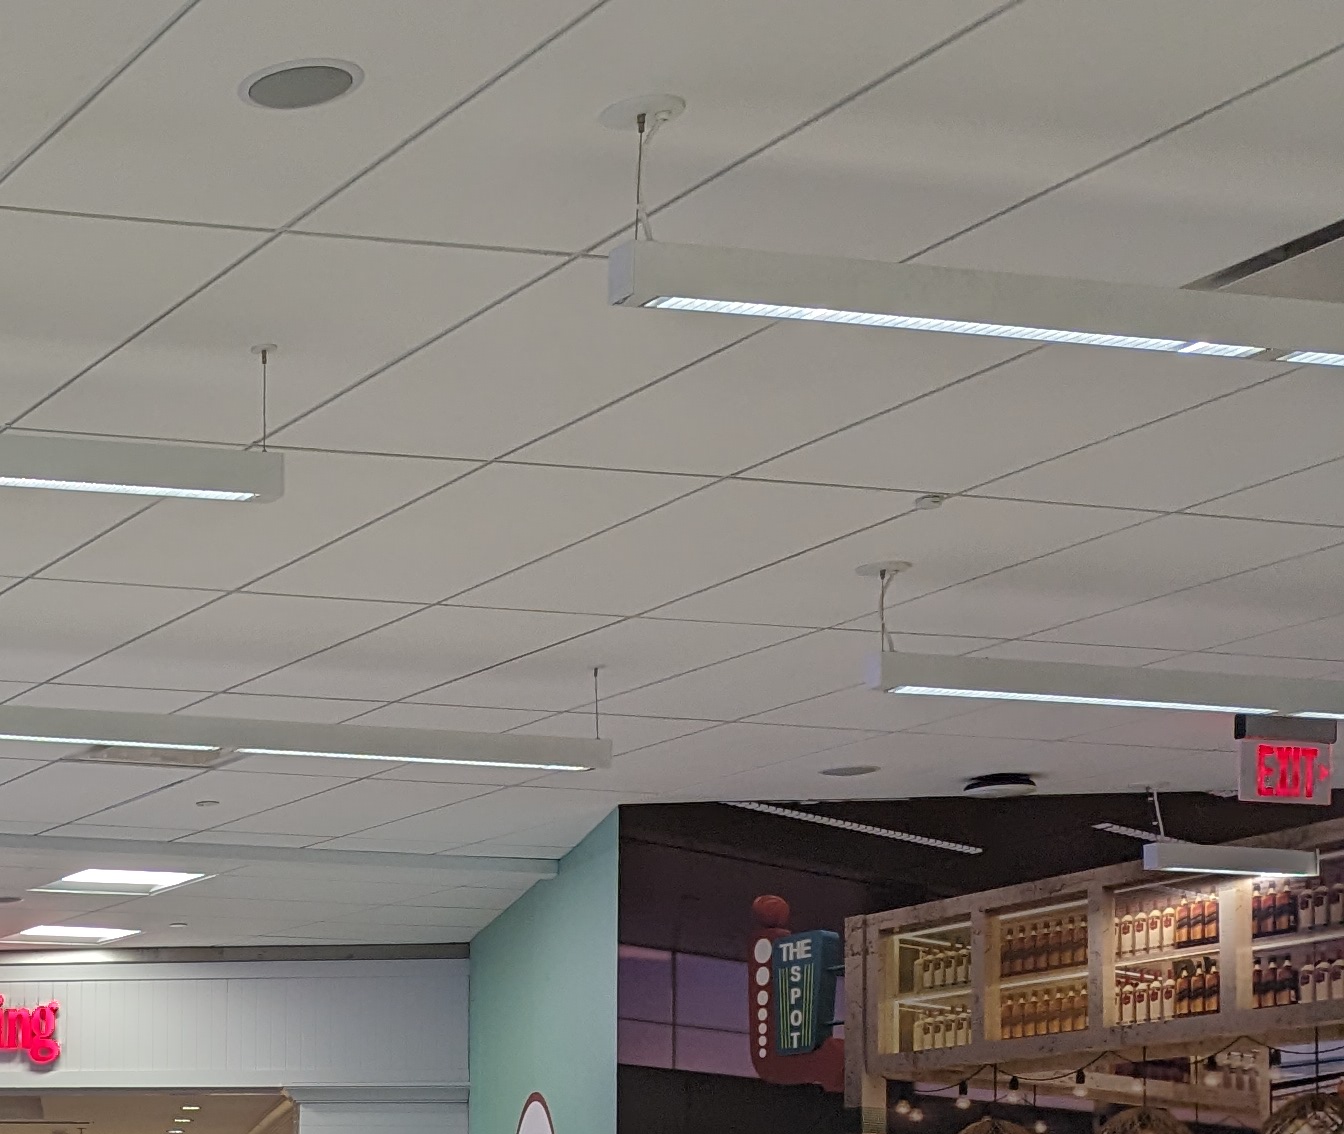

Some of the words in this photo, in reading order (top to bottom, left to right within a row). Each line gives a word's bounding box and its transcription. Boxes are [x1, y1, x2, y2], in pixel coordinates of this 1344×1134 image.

[1257, 744, 1319, 798] EXIT
[779, 939, 812, 962] THE
[790, 965, 803, 1049] SPOT
